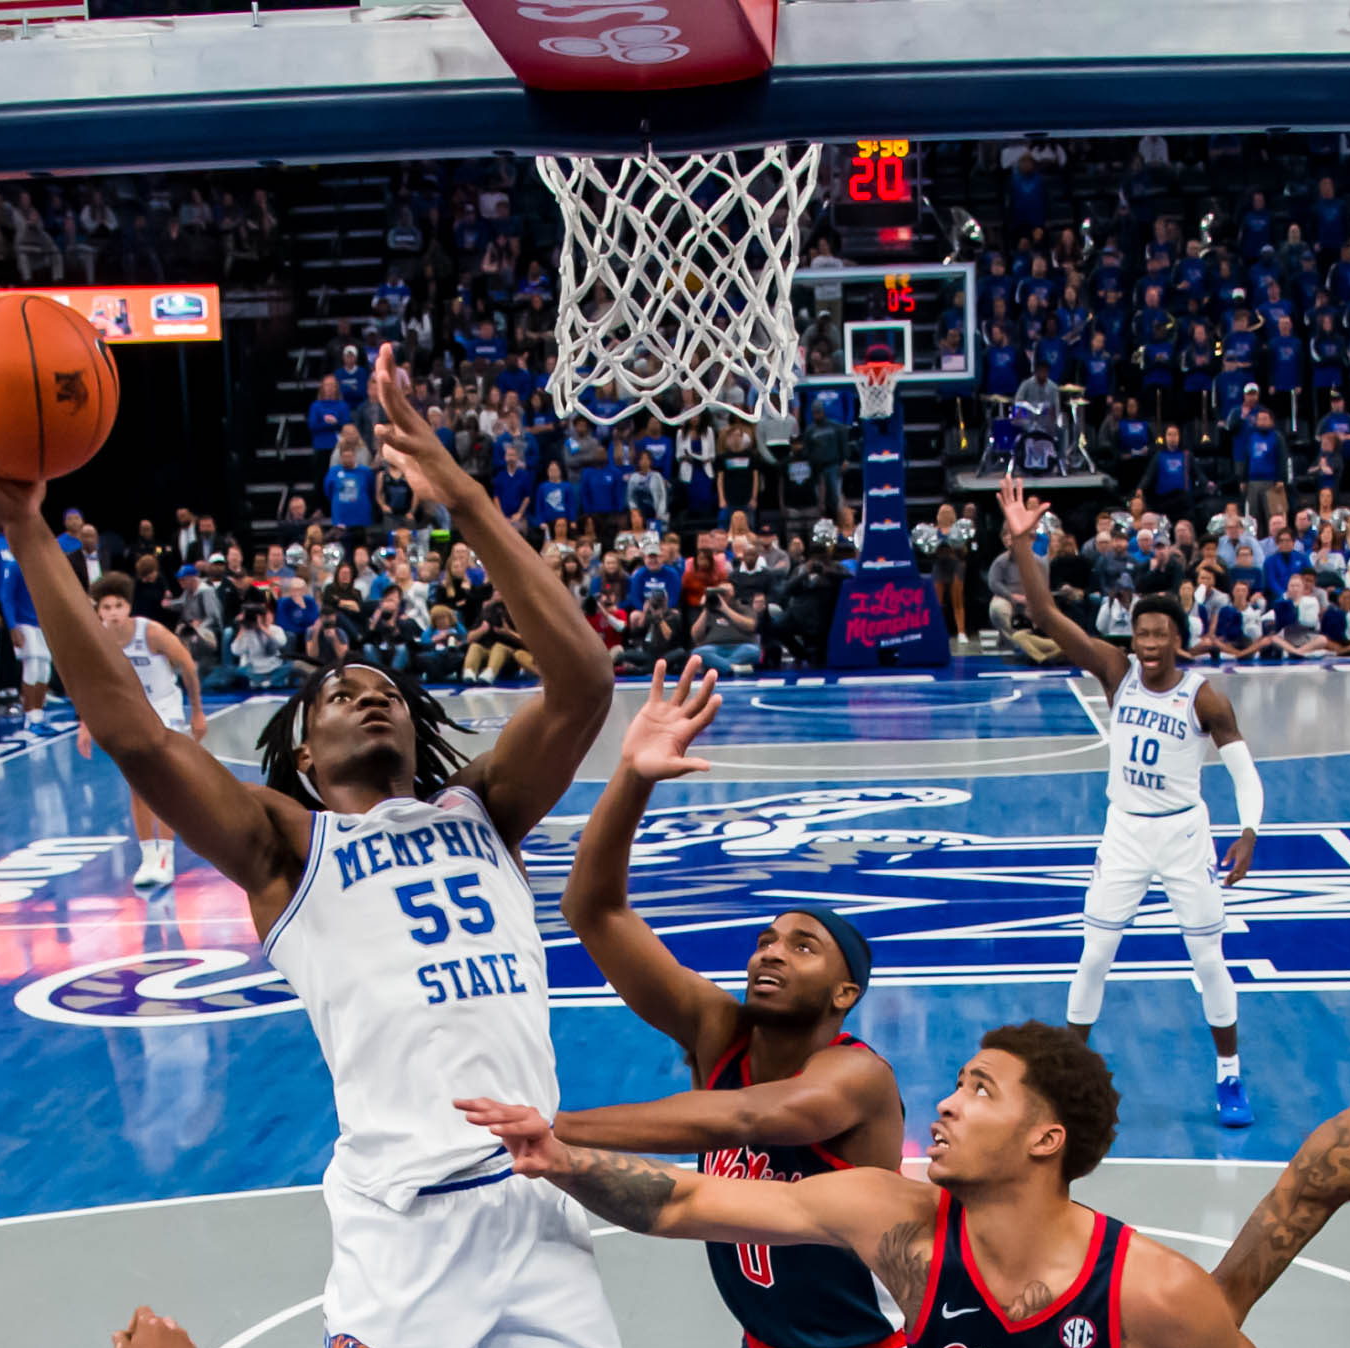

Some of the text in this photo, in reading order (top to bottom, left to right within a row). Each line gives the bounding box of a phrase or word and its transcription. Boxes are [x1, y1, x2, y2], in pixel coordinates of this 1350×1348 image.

[849, 156, 903, 200] 20
[849, 582, 924, 615] I Love
[846, 608, 930, 648] Memphis
[1117, 706, 1188, 740] MEMPHIS
[1130, 735, 1159, 766] 10
[334, 821, 499, 891] MEMPHIS
[395, 873, 495, 945] 55
[417, 954, 526, 1004] STATE
